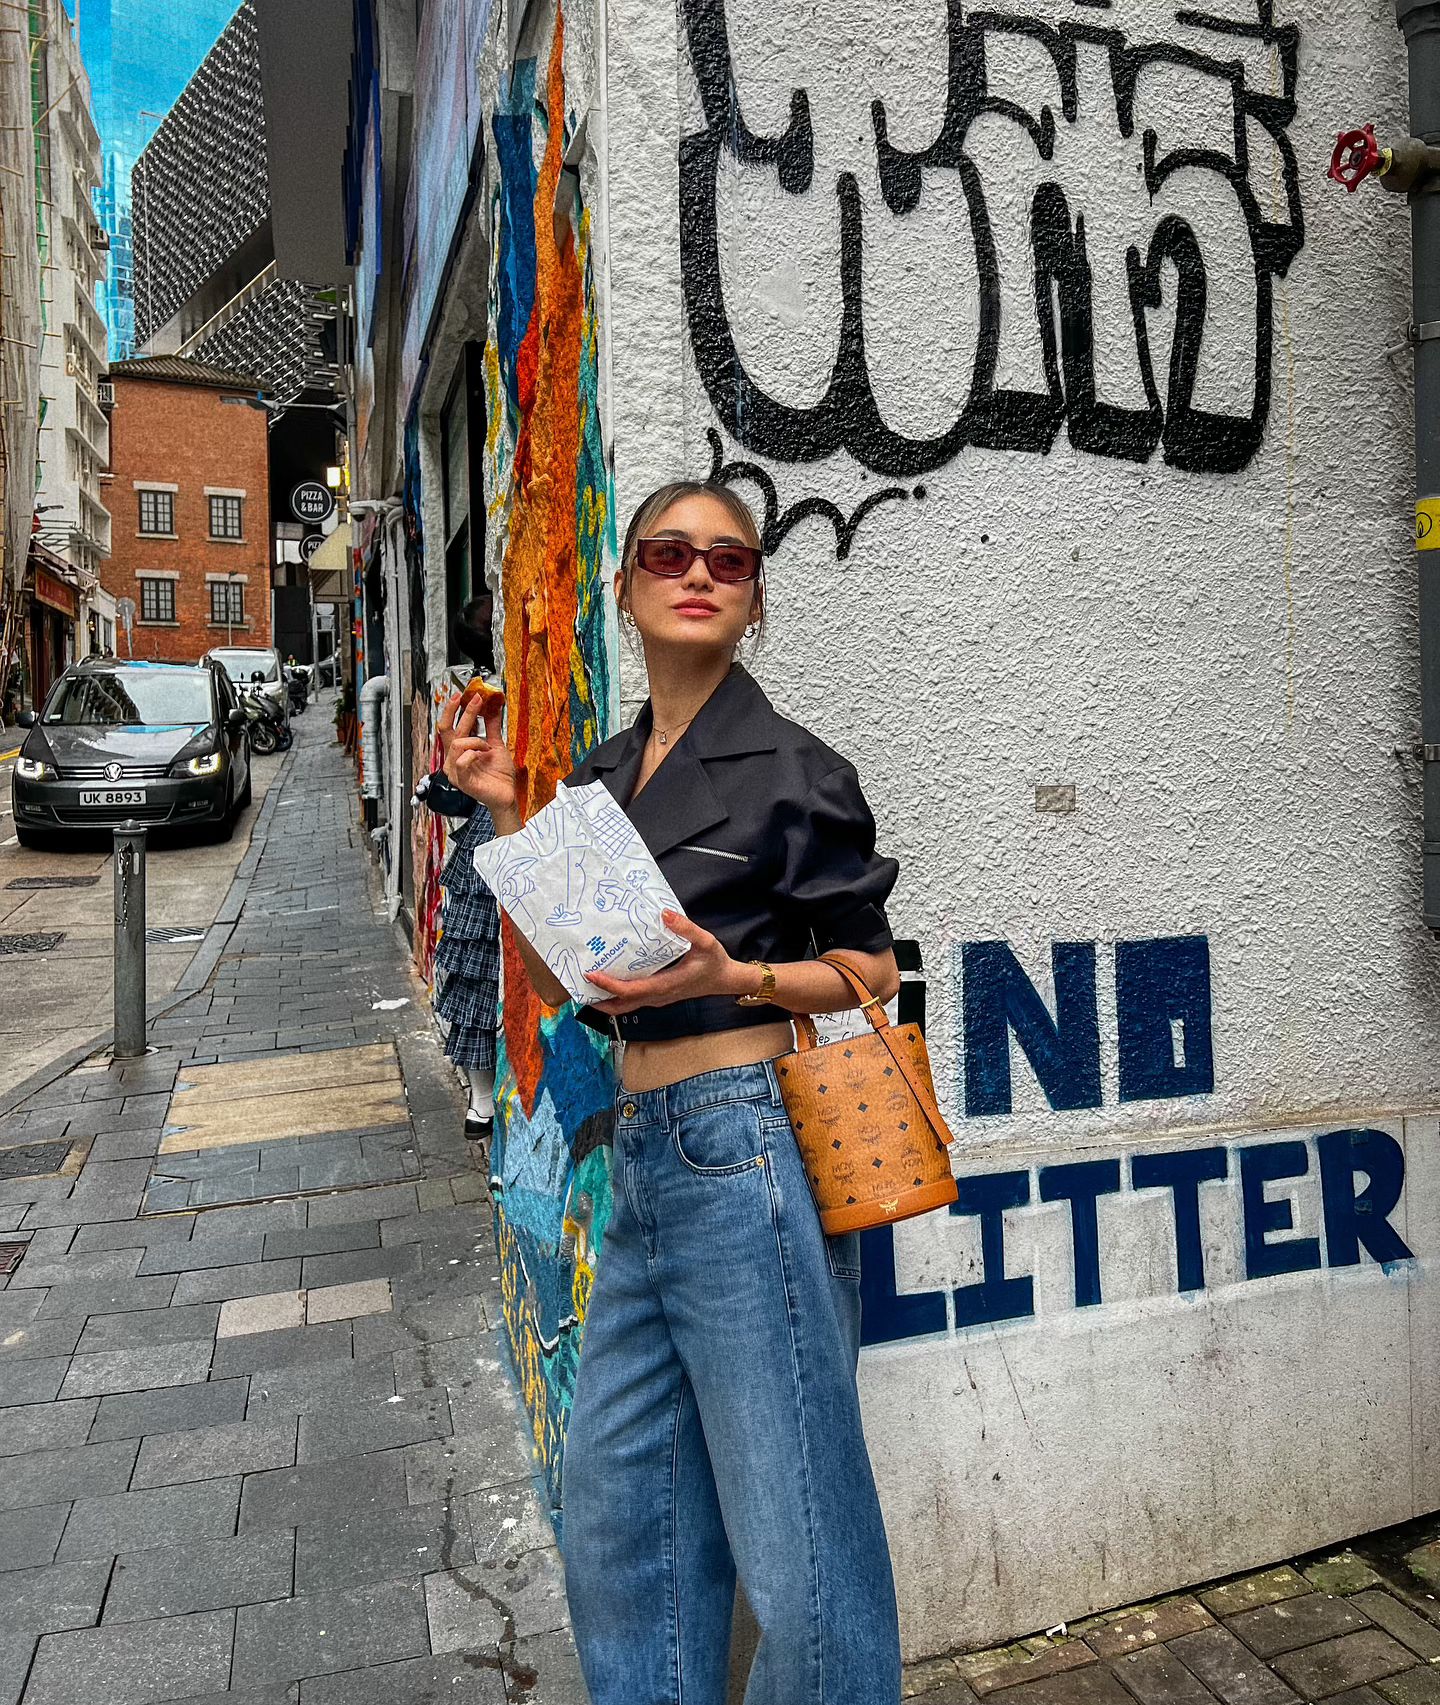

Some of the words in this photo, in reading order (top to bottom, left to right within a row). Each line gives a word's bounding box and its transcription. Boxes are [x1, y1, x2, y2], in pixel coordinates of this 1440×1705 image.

[301, 490, 323, 501] PIZZA
[307, 541, 321, 549] PIZZ
[83, 793, 101, 804] UK
[105, 792, 142, 803] 8893
[860, 1128, 1415, 1346] LITTER
